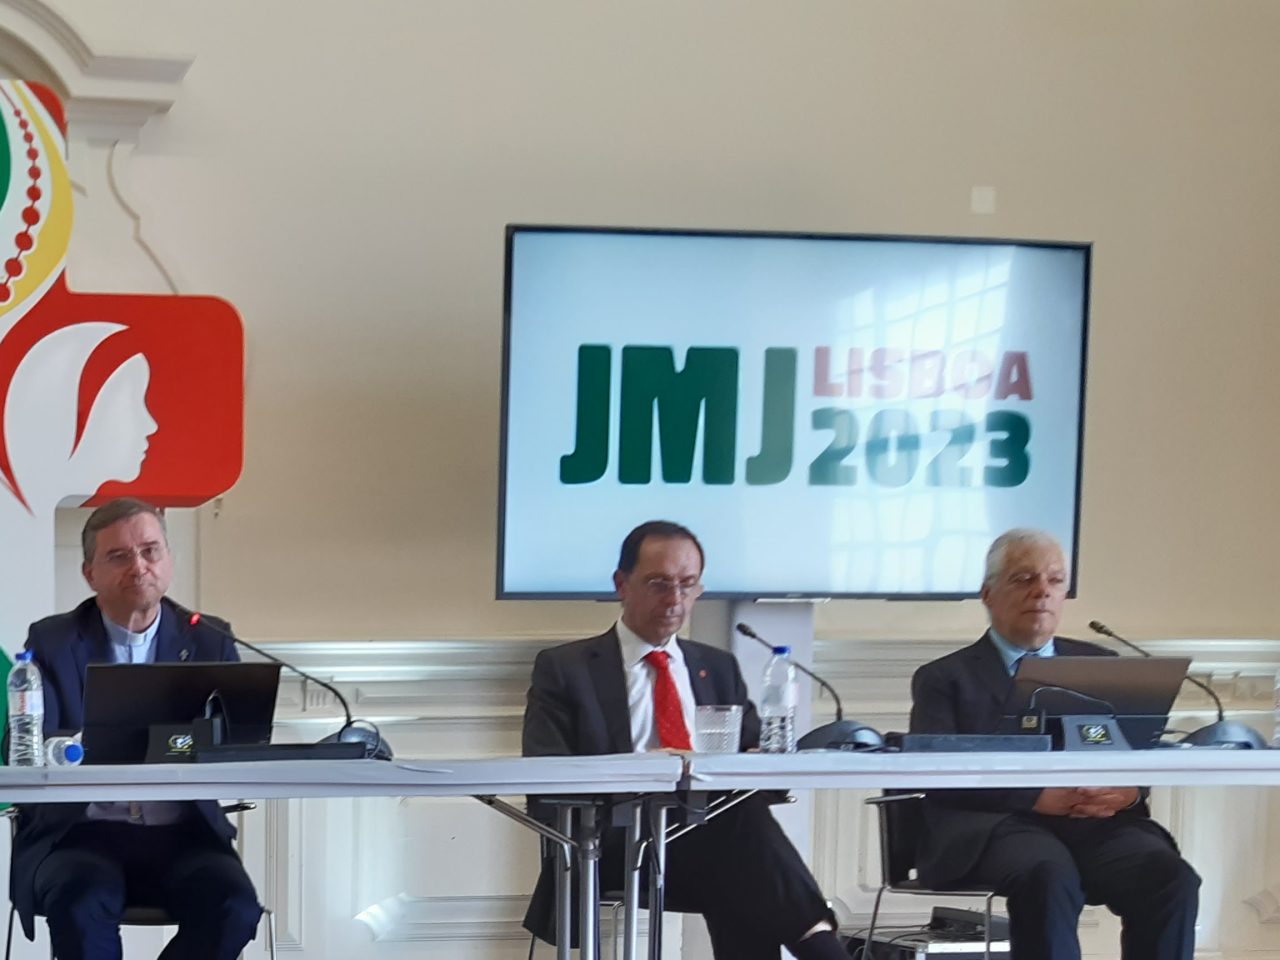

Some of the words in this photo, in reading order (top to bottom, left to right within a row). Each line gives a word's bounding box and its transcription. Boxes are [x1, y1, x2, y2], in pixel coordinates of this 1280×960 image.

[813, 345, 1033, 402] LISBOA
[560, 344, 798, 486] JMJ
[808, 407, 1032, 488] 2023
